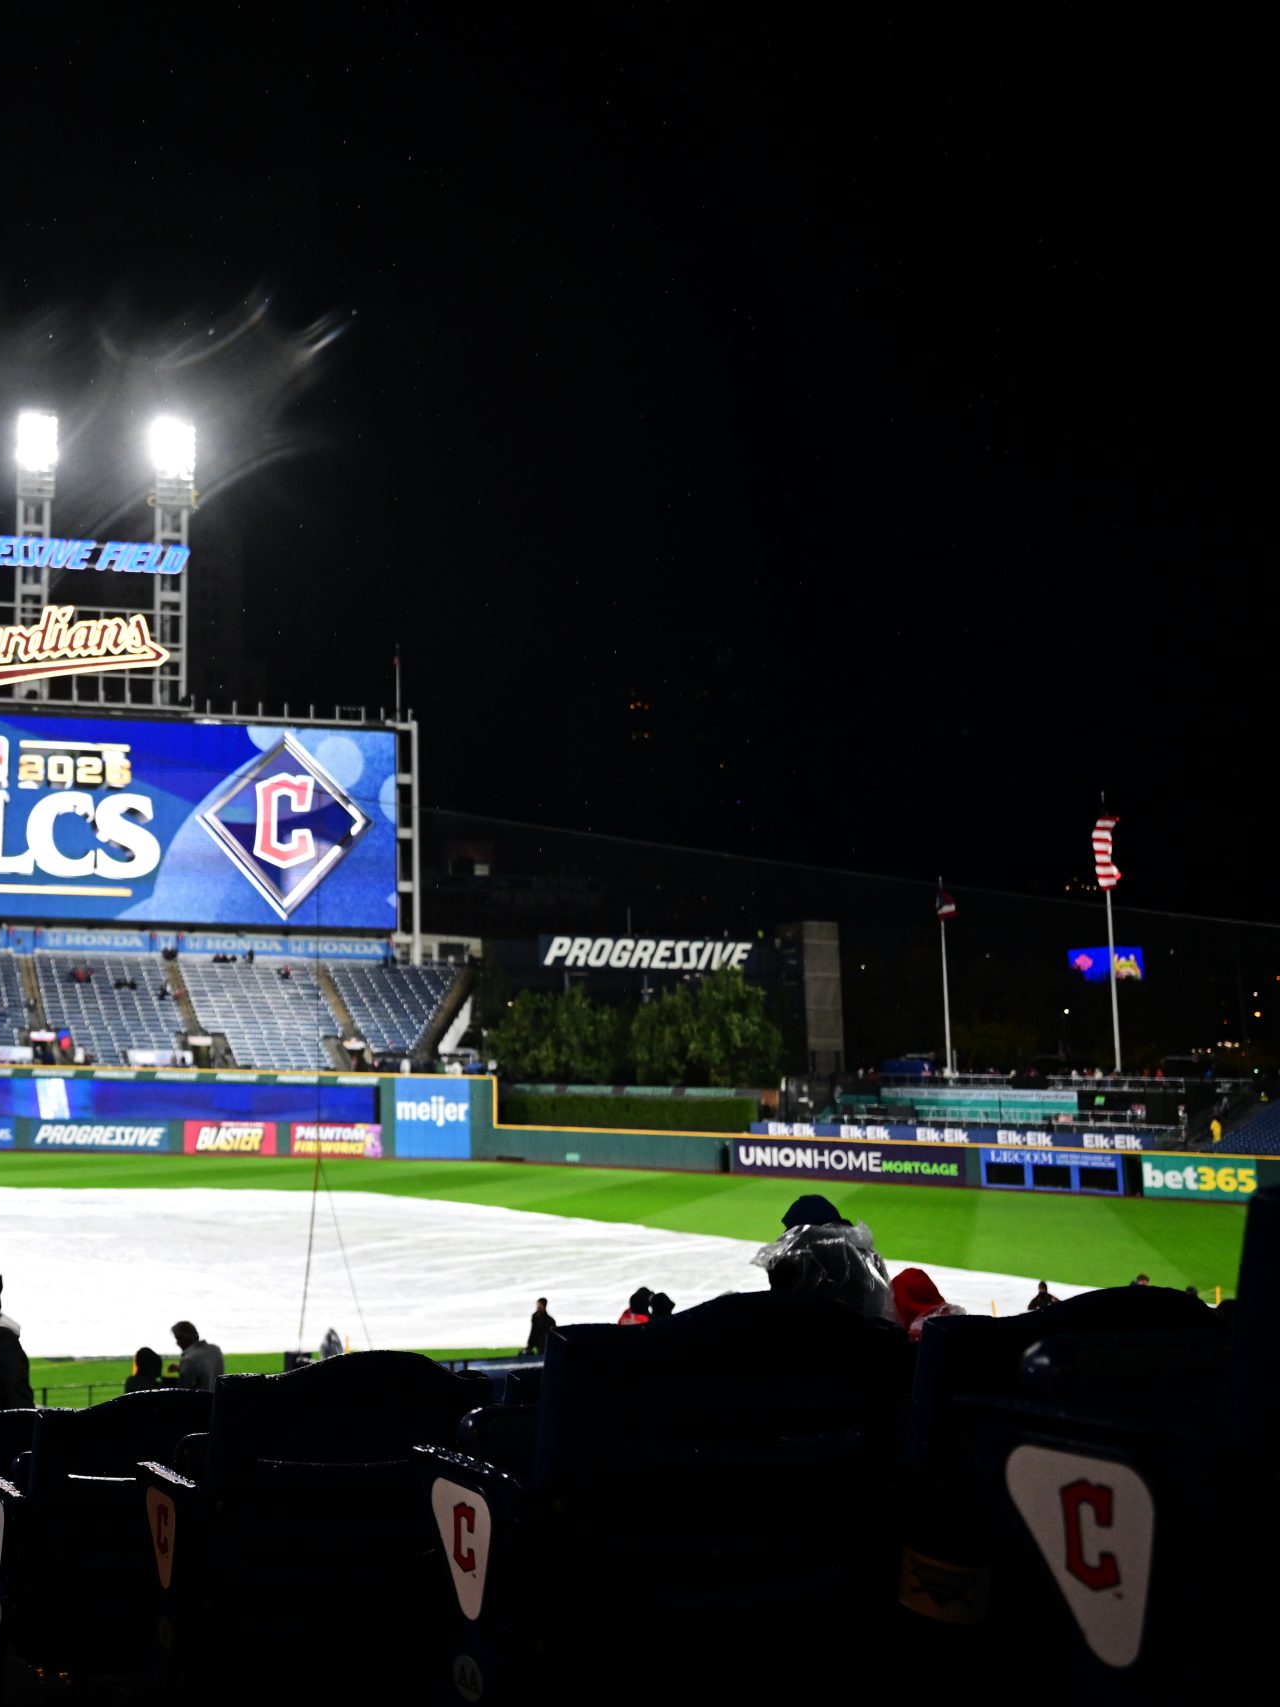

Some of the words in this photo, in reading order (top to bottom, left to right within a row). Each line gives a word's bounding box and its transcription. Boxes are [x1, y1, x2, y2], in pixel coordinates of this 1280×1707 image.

[95, 541, 190, 574] FIELD
[253, 772, 315, 869] C
[65, 934, 143, 947] HONDA
[206, 937, 282, 952] HONDA
[308, 940, 383, 955] HONDA
[543, 936, 752, 970] PROGRESSIVE
[396, 1095, 468, 1127] meijer
[35, 1124, 164, 1147] PROGRESSIVE
[196, 1126, 264, 1152] BLASTER
[295, 1125, 366, 1141] PHANTOM
[739, 1146, 882, 1173] UNIONHOME
[881, 1161, 958, 1176] MORTGAGE
[1142, 1163, 1257, 1193] bet365
[157, 1503, 168, 1553] C
[454, 1502, 475, 1572] C
[1060, 1480, 1119, 1591] C
